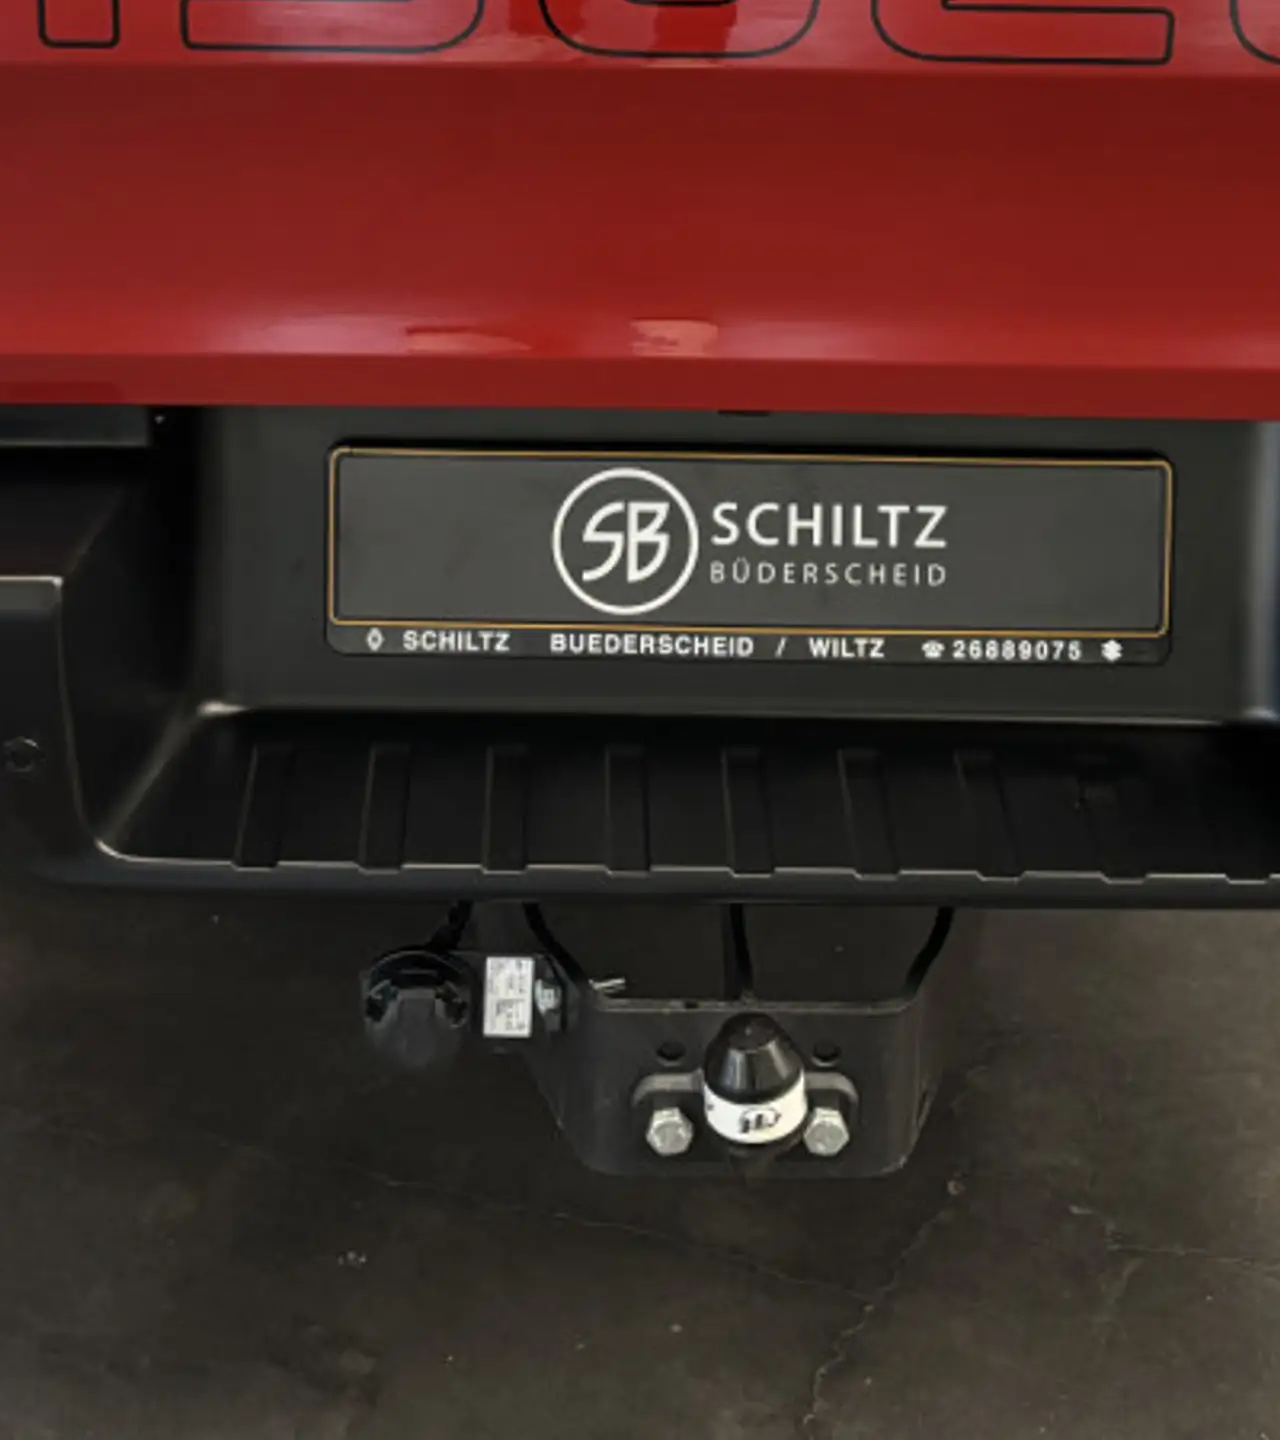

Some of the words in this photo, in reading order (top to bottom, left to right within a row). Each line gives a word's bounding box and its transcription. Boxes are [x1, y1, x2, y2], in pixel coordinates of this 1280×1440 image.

[581, 501, 671, 584] SB
[710, 502, 948, 549] SCHILTZ
[710, 558, 947, 587] BÜDERSCHEID
[403, 630, 510, 652] SCHILTZ
[550, 633, 754, 657] BUEDERSCHEID
[808, 637, 886, 658] WILTZ
